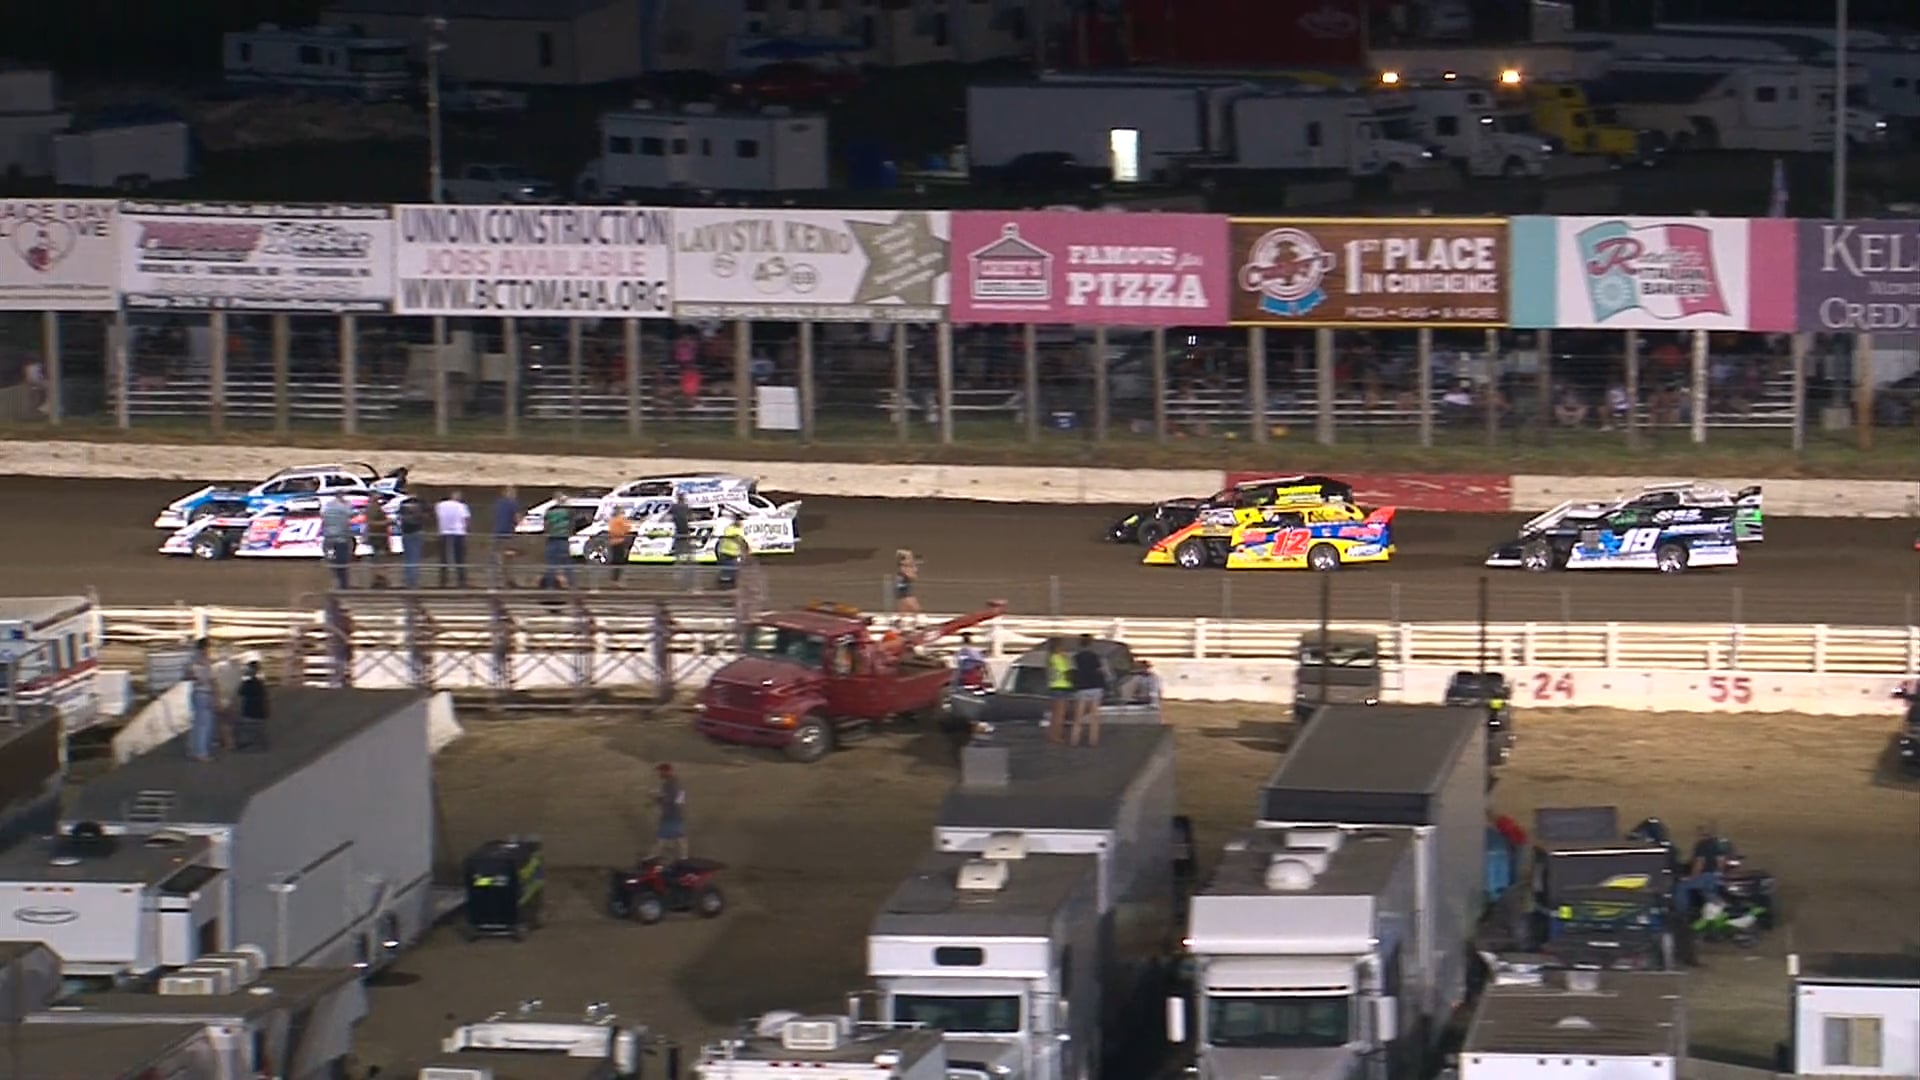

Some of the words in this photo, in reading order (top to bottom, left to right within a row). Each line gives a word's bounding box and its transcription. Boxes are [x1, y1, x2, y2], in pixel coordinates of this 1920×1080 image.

[401, 208, 480, 244] UNION
[484, 208, 667, 245] CONSTRUCTION
[677, 220, 779, 252] LAVISTA
[783, 220, 850, 254] KENO
[424, 250, 490, 275] JOBS
[499, 250, 647, 277] AVAILABLE
[1067, 245, 1176, 266] FAMOUS
[1382, 238, 1497, 270] PLACE
[1820, 224, 1920, 276] KEL
[402, 278, 666, 312] WWW.BCTOMAHA.ORG
[1066, 272, 1210, 308] PIZZA
[278, 516, 323, 543] 20
[1272, 527, 1313, 556] 12
[1620, 528, 1661, 553] 19
[1533, 672, 1575, 700] 24
[1707, 676, 1753, 703] 55
